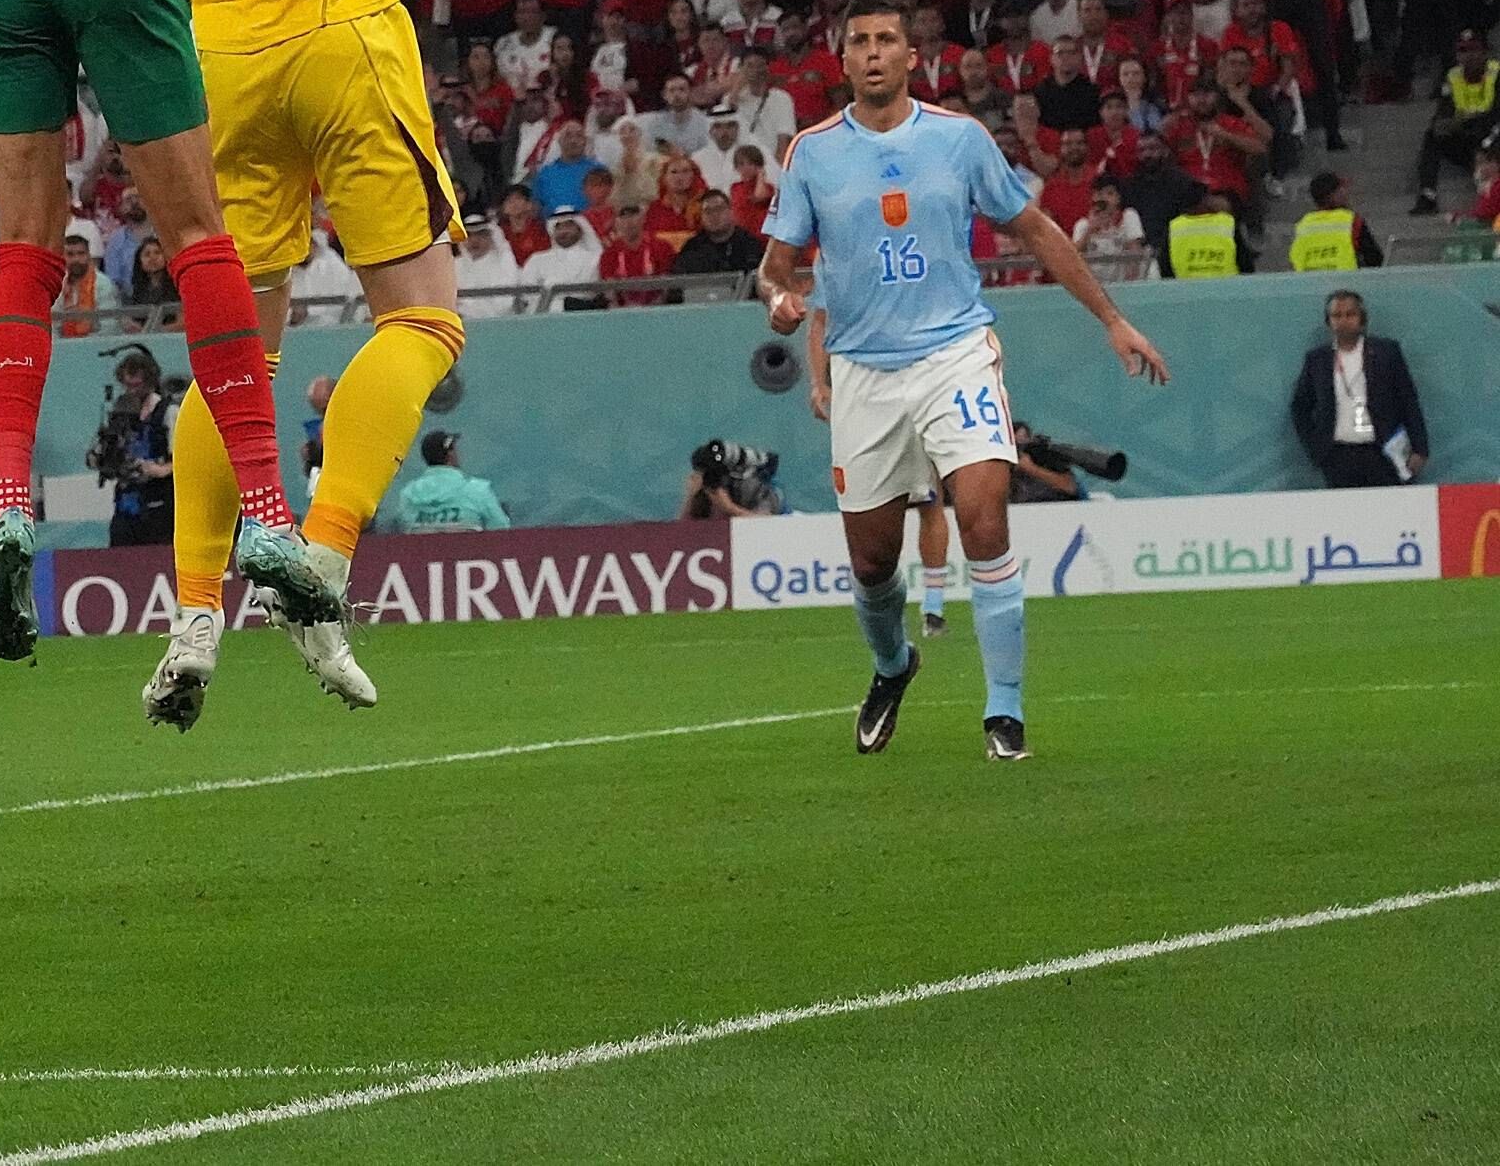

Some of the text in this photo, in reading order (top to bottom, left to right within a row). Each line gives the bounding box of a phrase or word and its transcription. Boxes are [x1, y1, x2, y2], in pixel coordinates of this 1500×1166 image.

[877, 236, 928, 285] 16
[953, 385, 1001, 430] 16
[1134, 531, 1422, 584] قطر للطاقة
[369, 548, 728, 624] AIRWAYS
